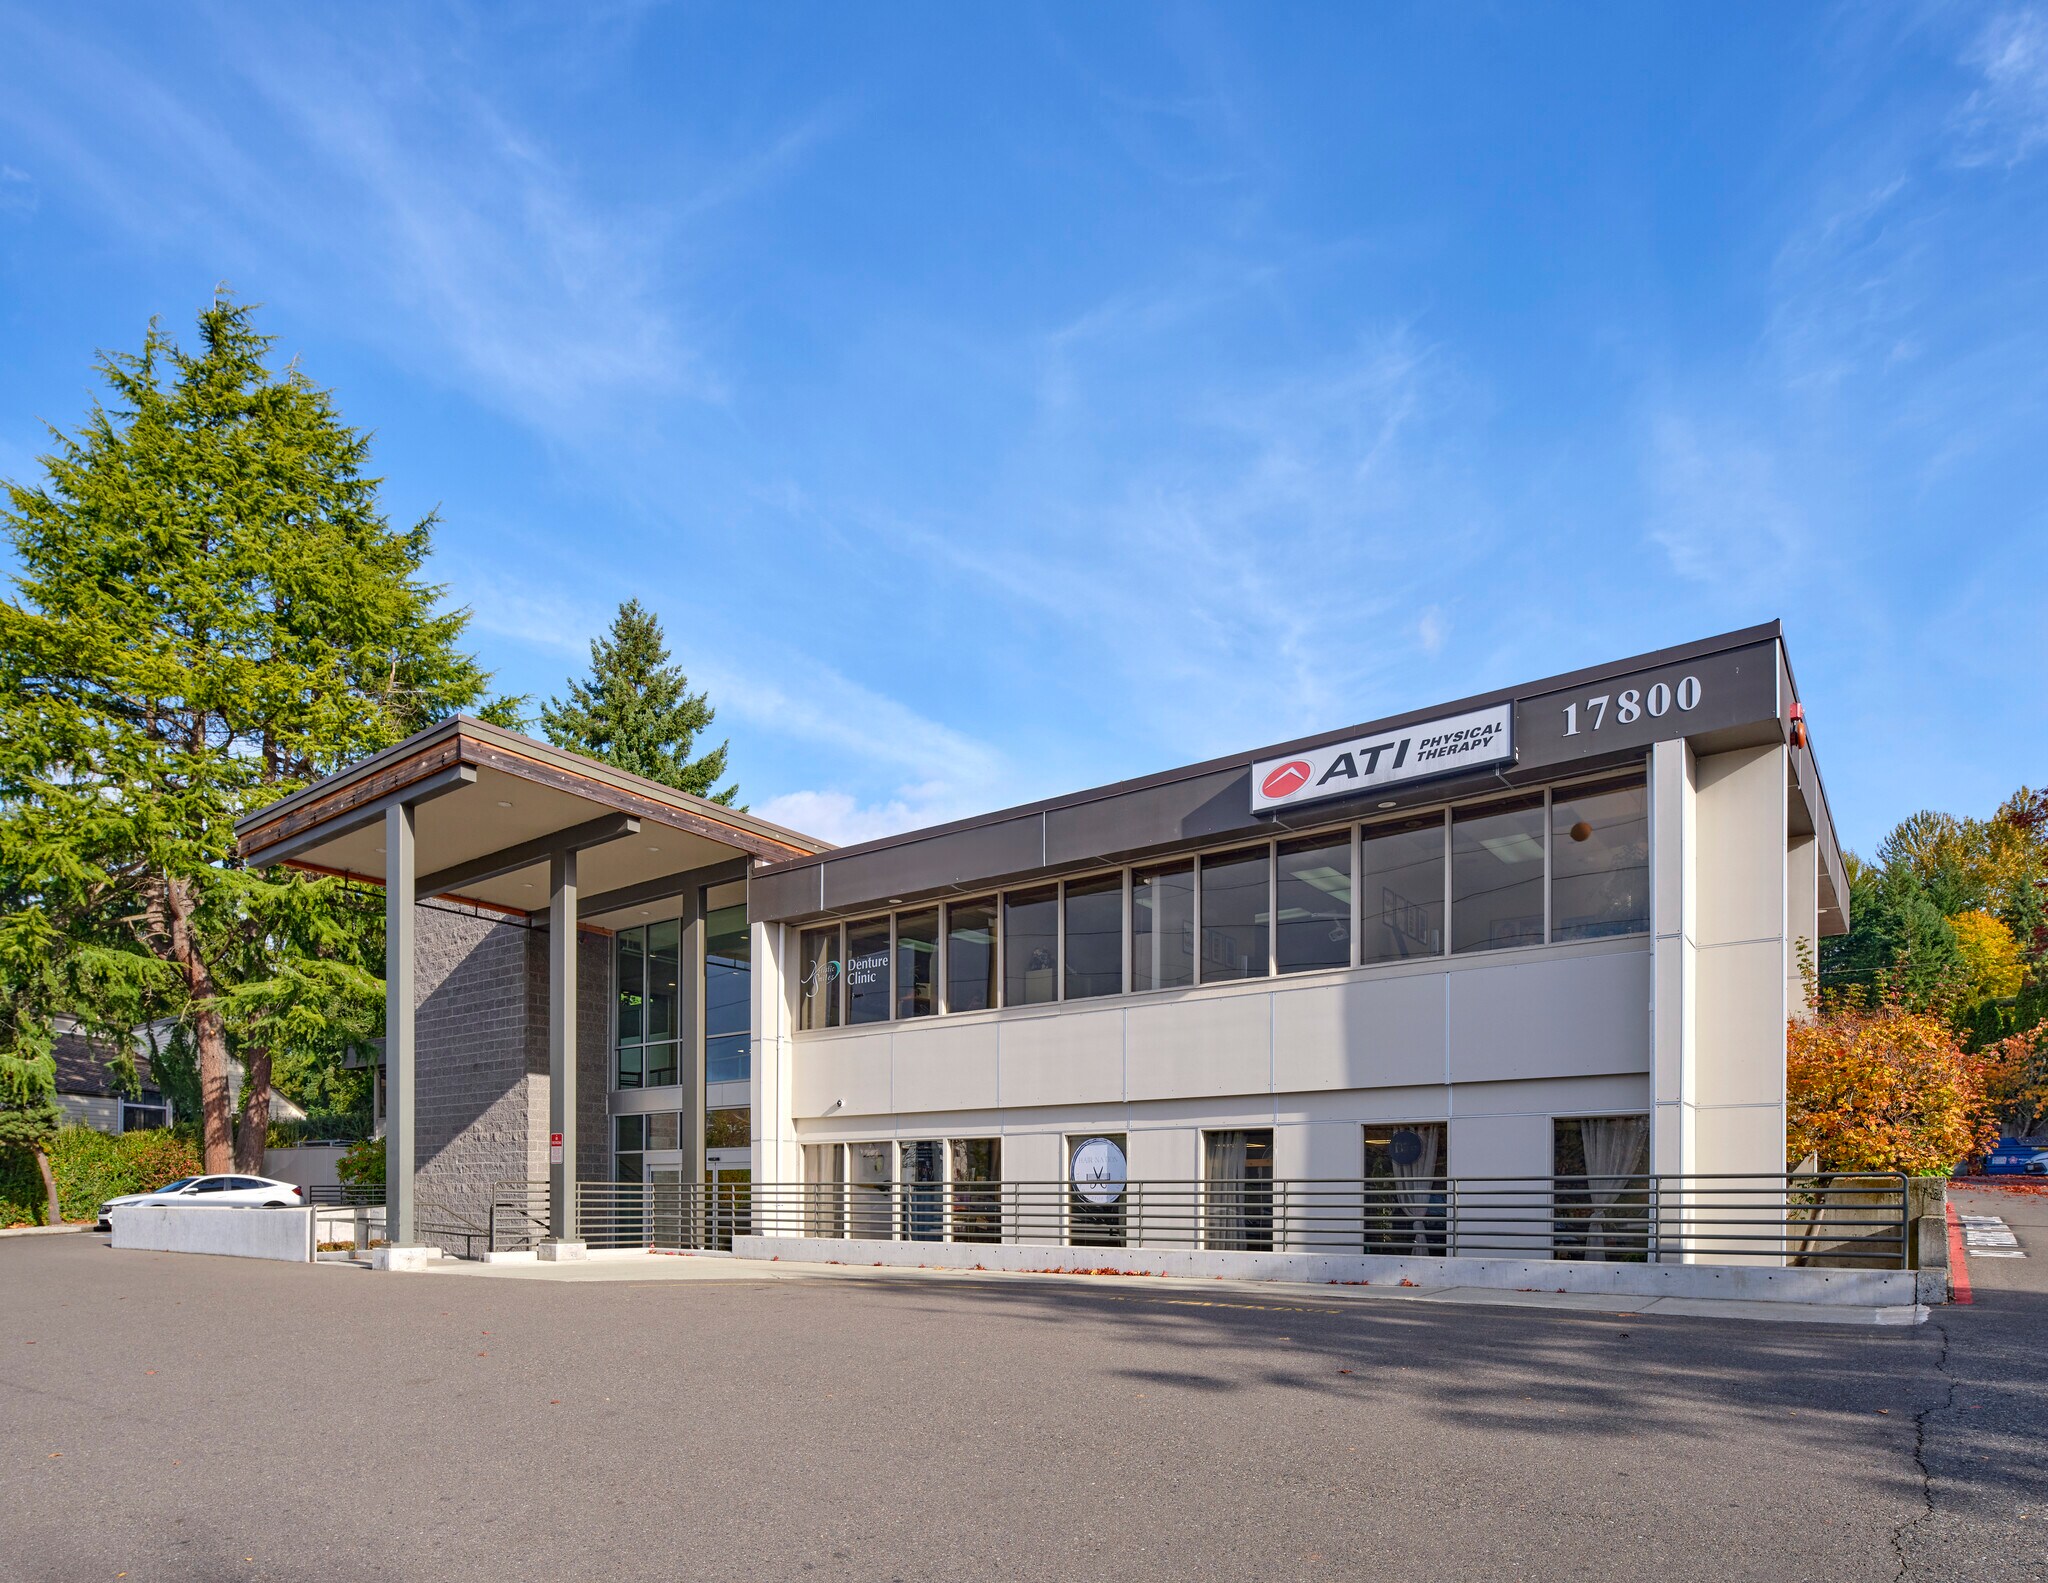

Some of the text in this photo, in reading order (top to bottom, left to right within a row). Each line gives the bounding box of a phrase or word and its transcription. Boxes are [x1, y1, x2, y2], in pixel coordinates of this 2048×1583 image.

[1562, 676, 1702, 737] 17800
[1419, 722, 1502, 749] PHYSICAL
[1417, 736, 1494, 762] THERAPY
[1316, 739, 1411, 786] ATI
[848, 956, 889, 971] Denture
[847, 971, 876, 985] Clinic
